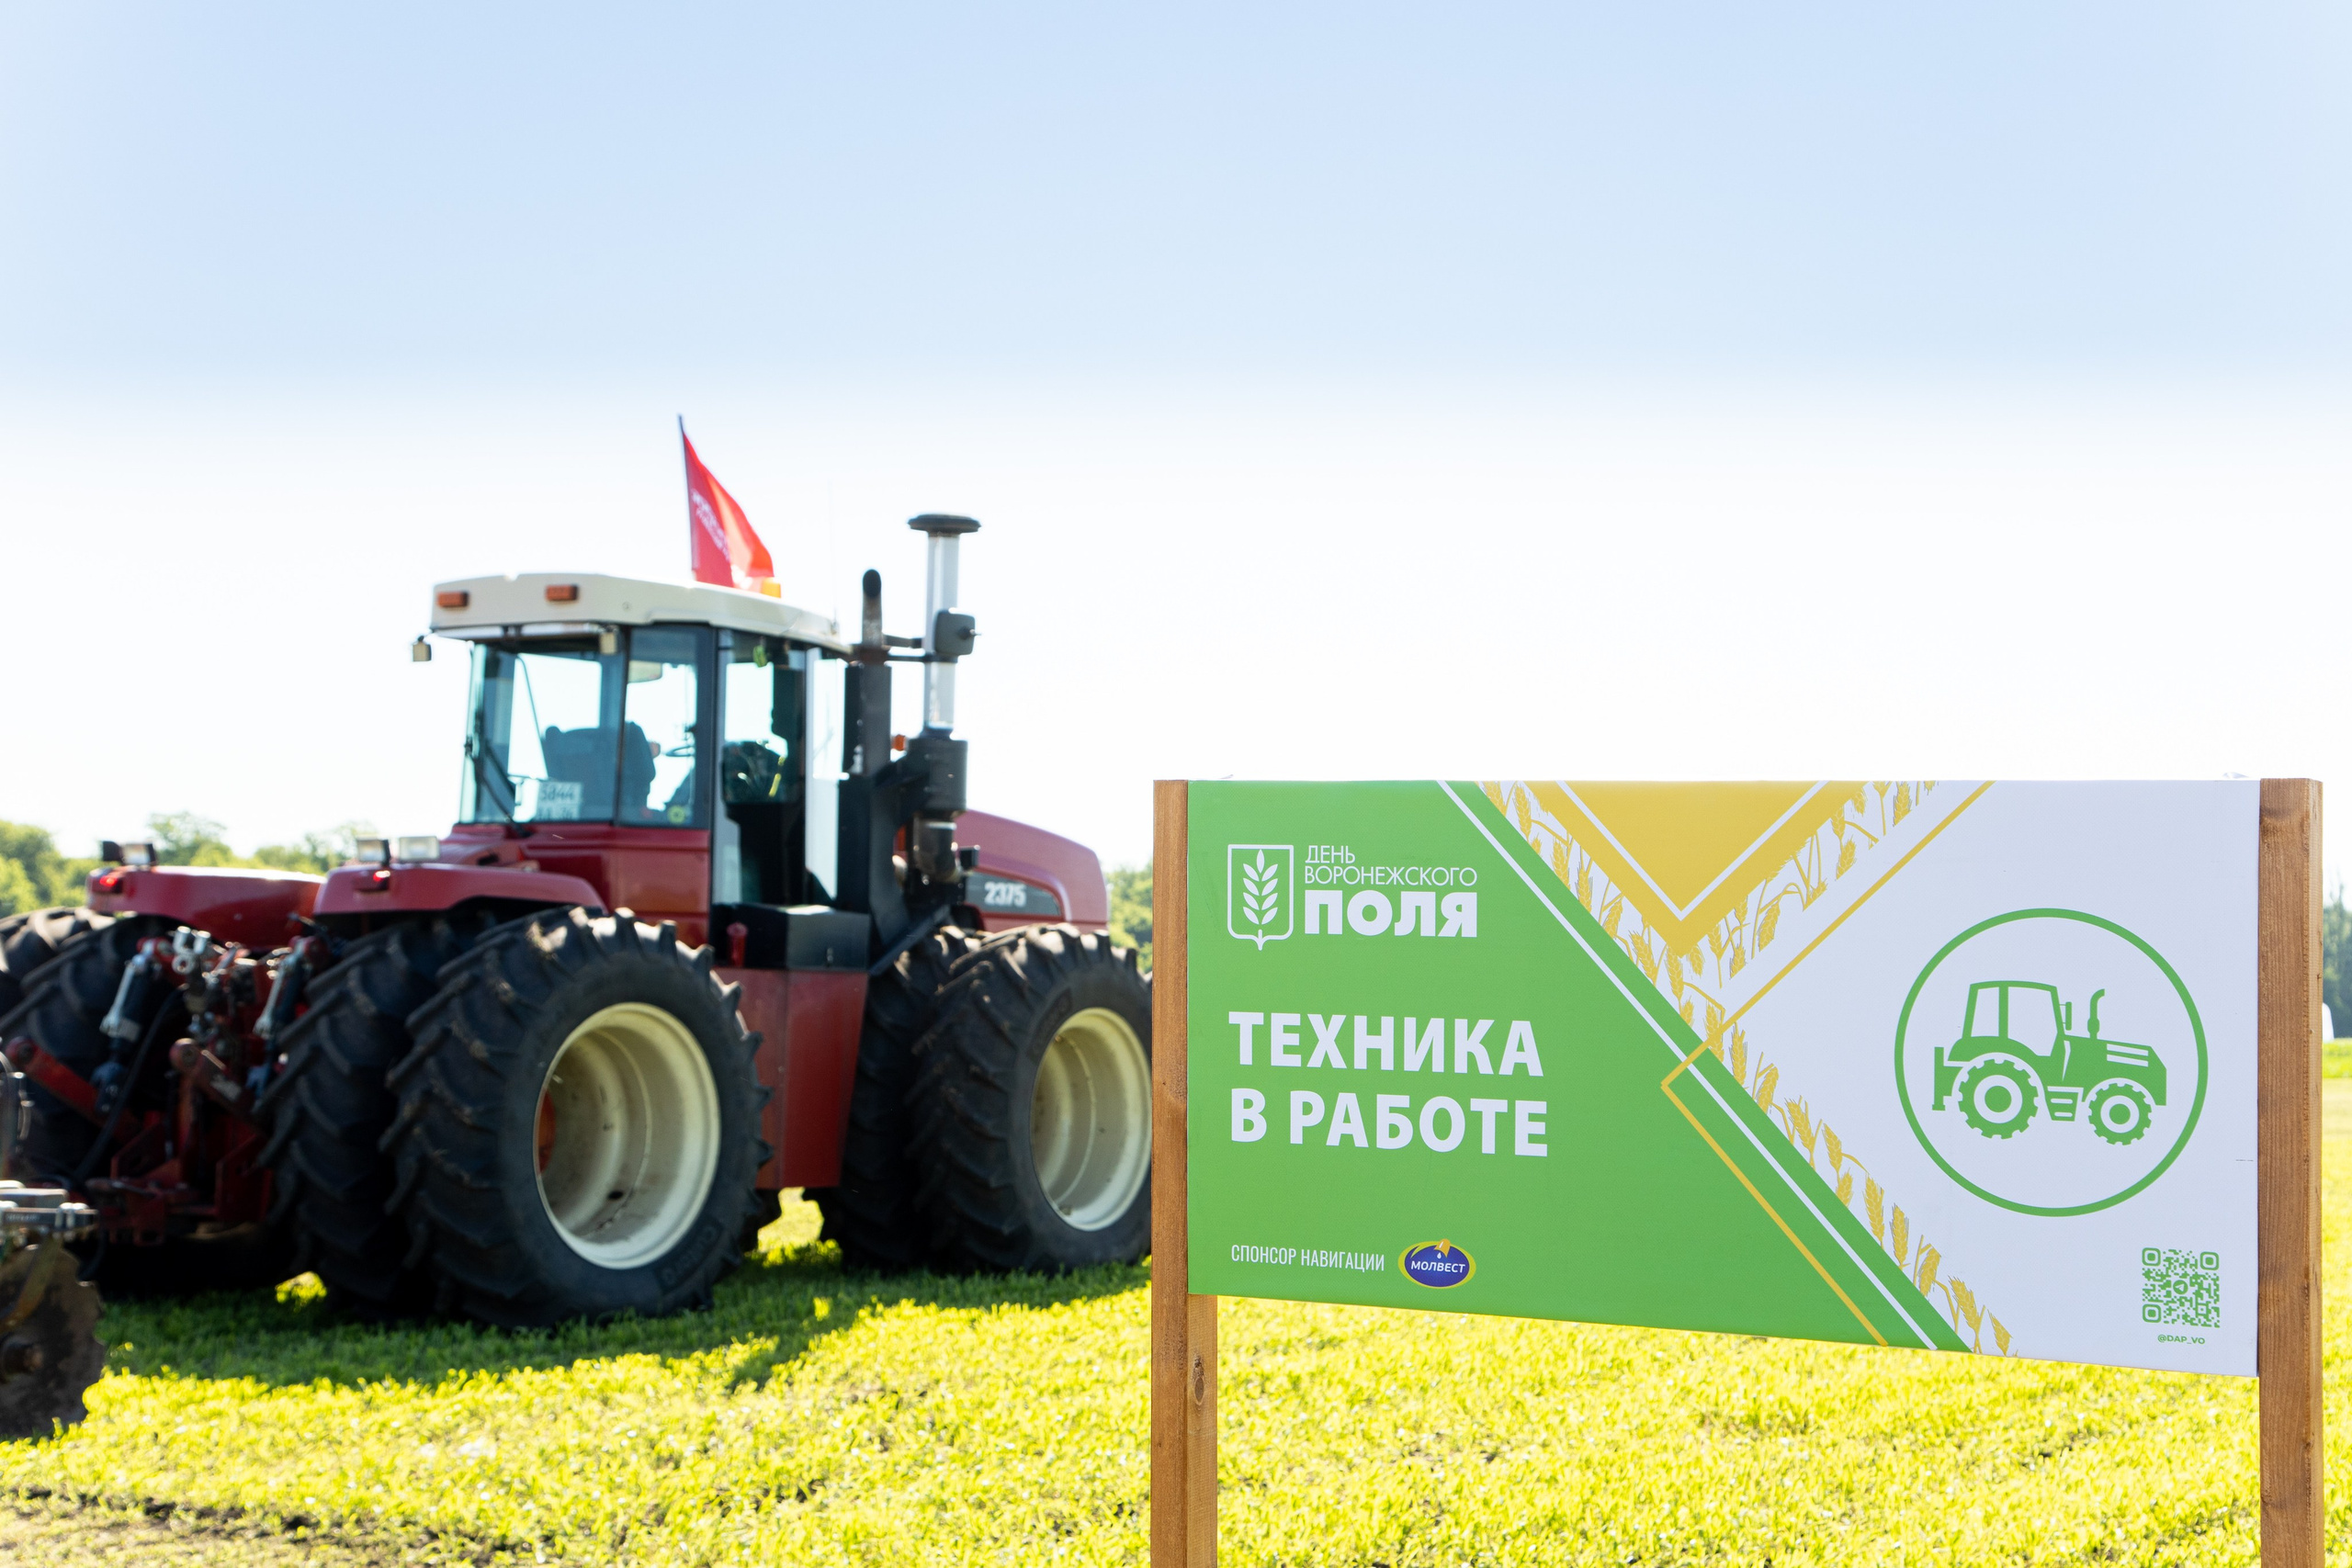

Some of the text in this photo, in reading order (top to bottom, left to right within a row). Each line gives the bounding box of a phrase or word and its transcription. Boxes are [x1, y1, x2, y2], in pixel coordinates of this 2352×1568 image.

[1305, 844, 1356, 865] ДЕНЬ
[1305, 864, 1478, 887] ВОРОНЕЖСКОГО
[983, 882, 1027, 908] 2375
[1305, 889, 1478, 938] ПОЛЯ
[1228, 1010, 1544, 1077] ТЕХНИКА
[1230, 1088, 1548, 1157] В РАБОТЕ
[1231, 1244, 1385, 1273] СПОНСОР НАВИГАЦИИ
[1410, 1260, 1466, 1273] МОЛВЕСТ
[2157, 1334, 2206, 1345] @DAP_VO
